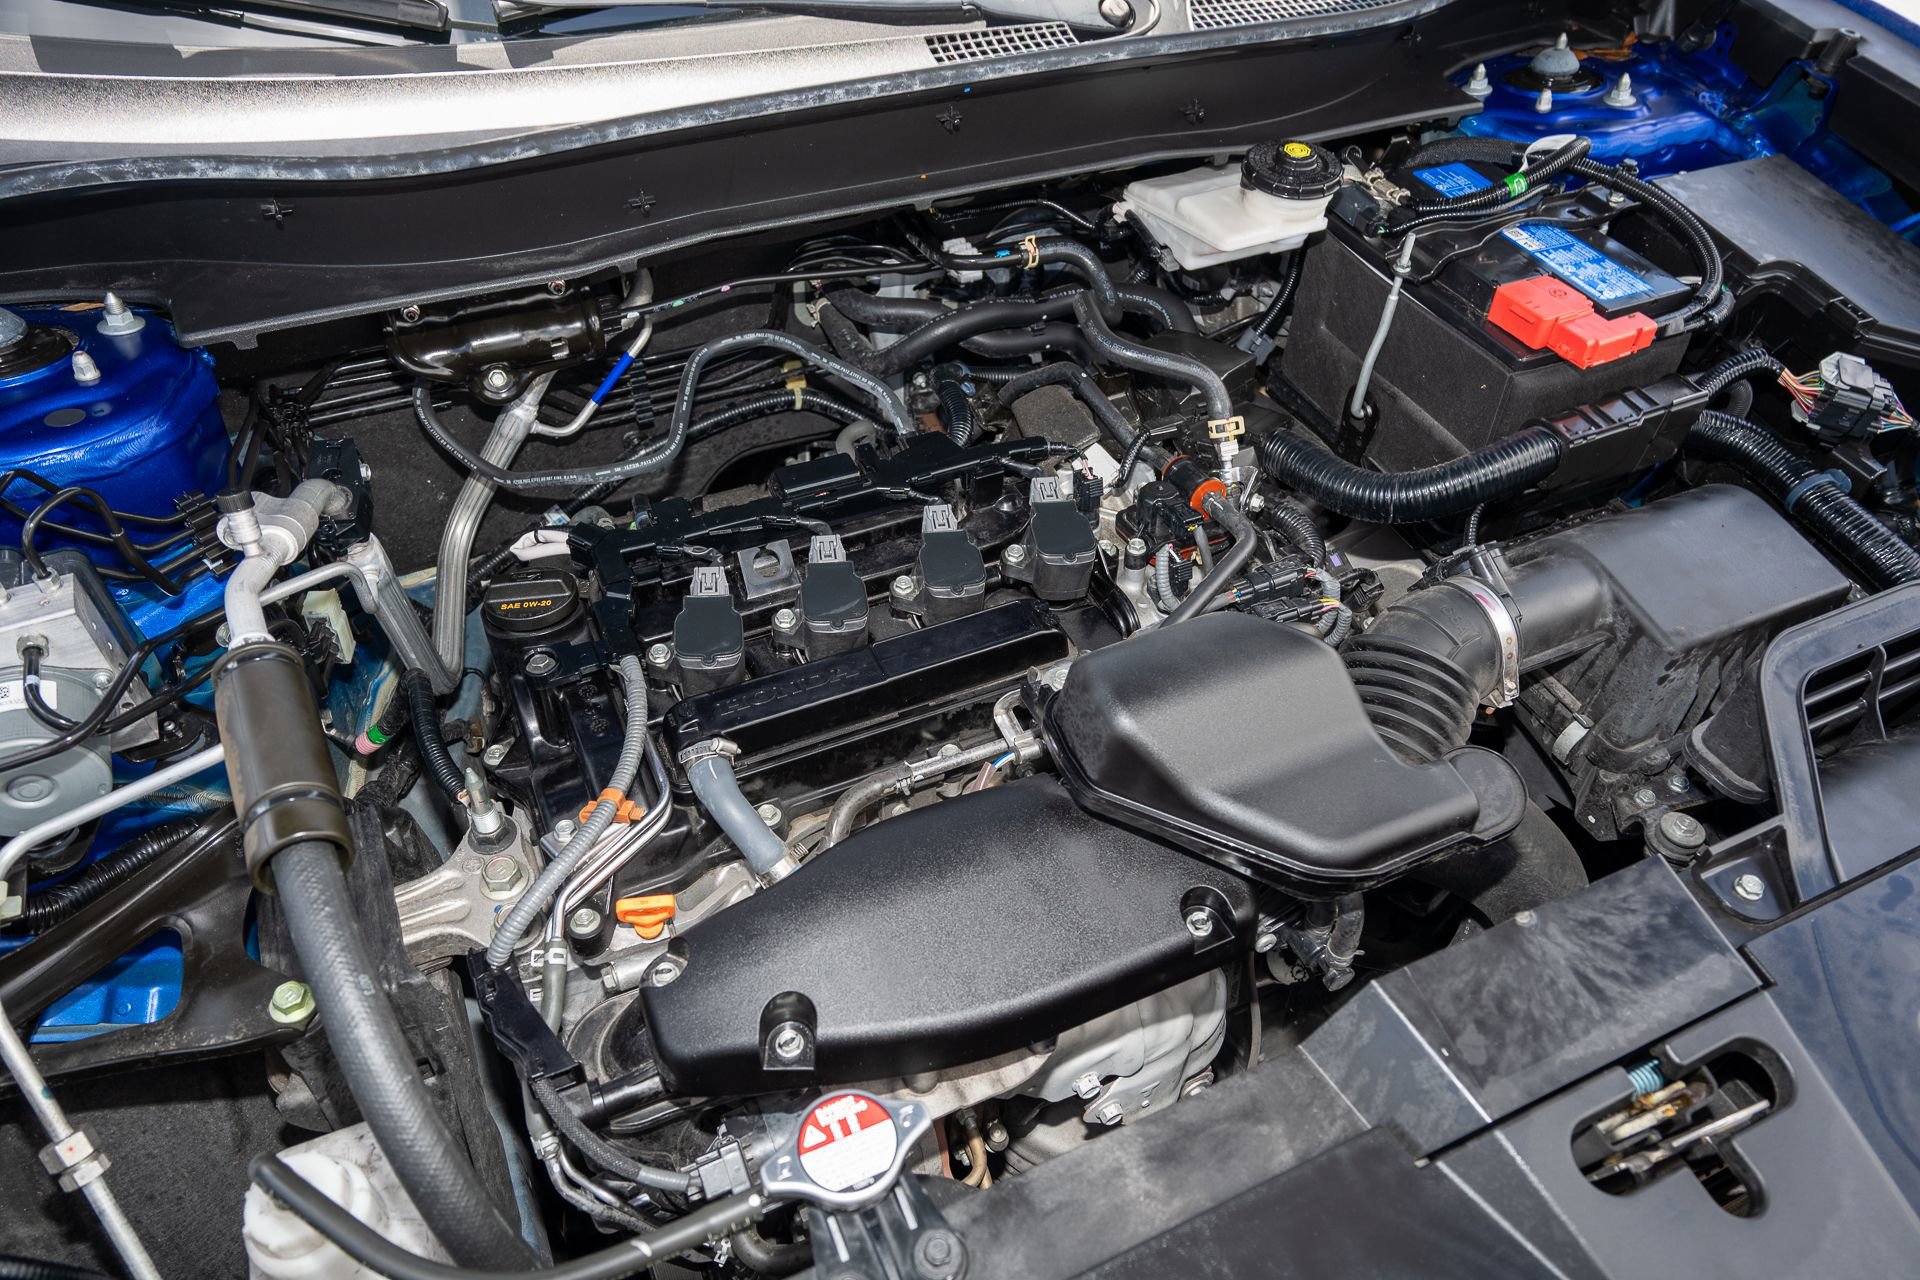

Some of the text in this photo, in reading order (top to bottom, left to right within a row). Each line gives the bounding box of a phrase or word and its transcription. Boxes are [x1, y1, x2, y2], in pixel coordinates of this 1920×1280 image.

[501, 600, 552, 610] SAE 0W-20
[719, 667, 861, 716] HONDA
